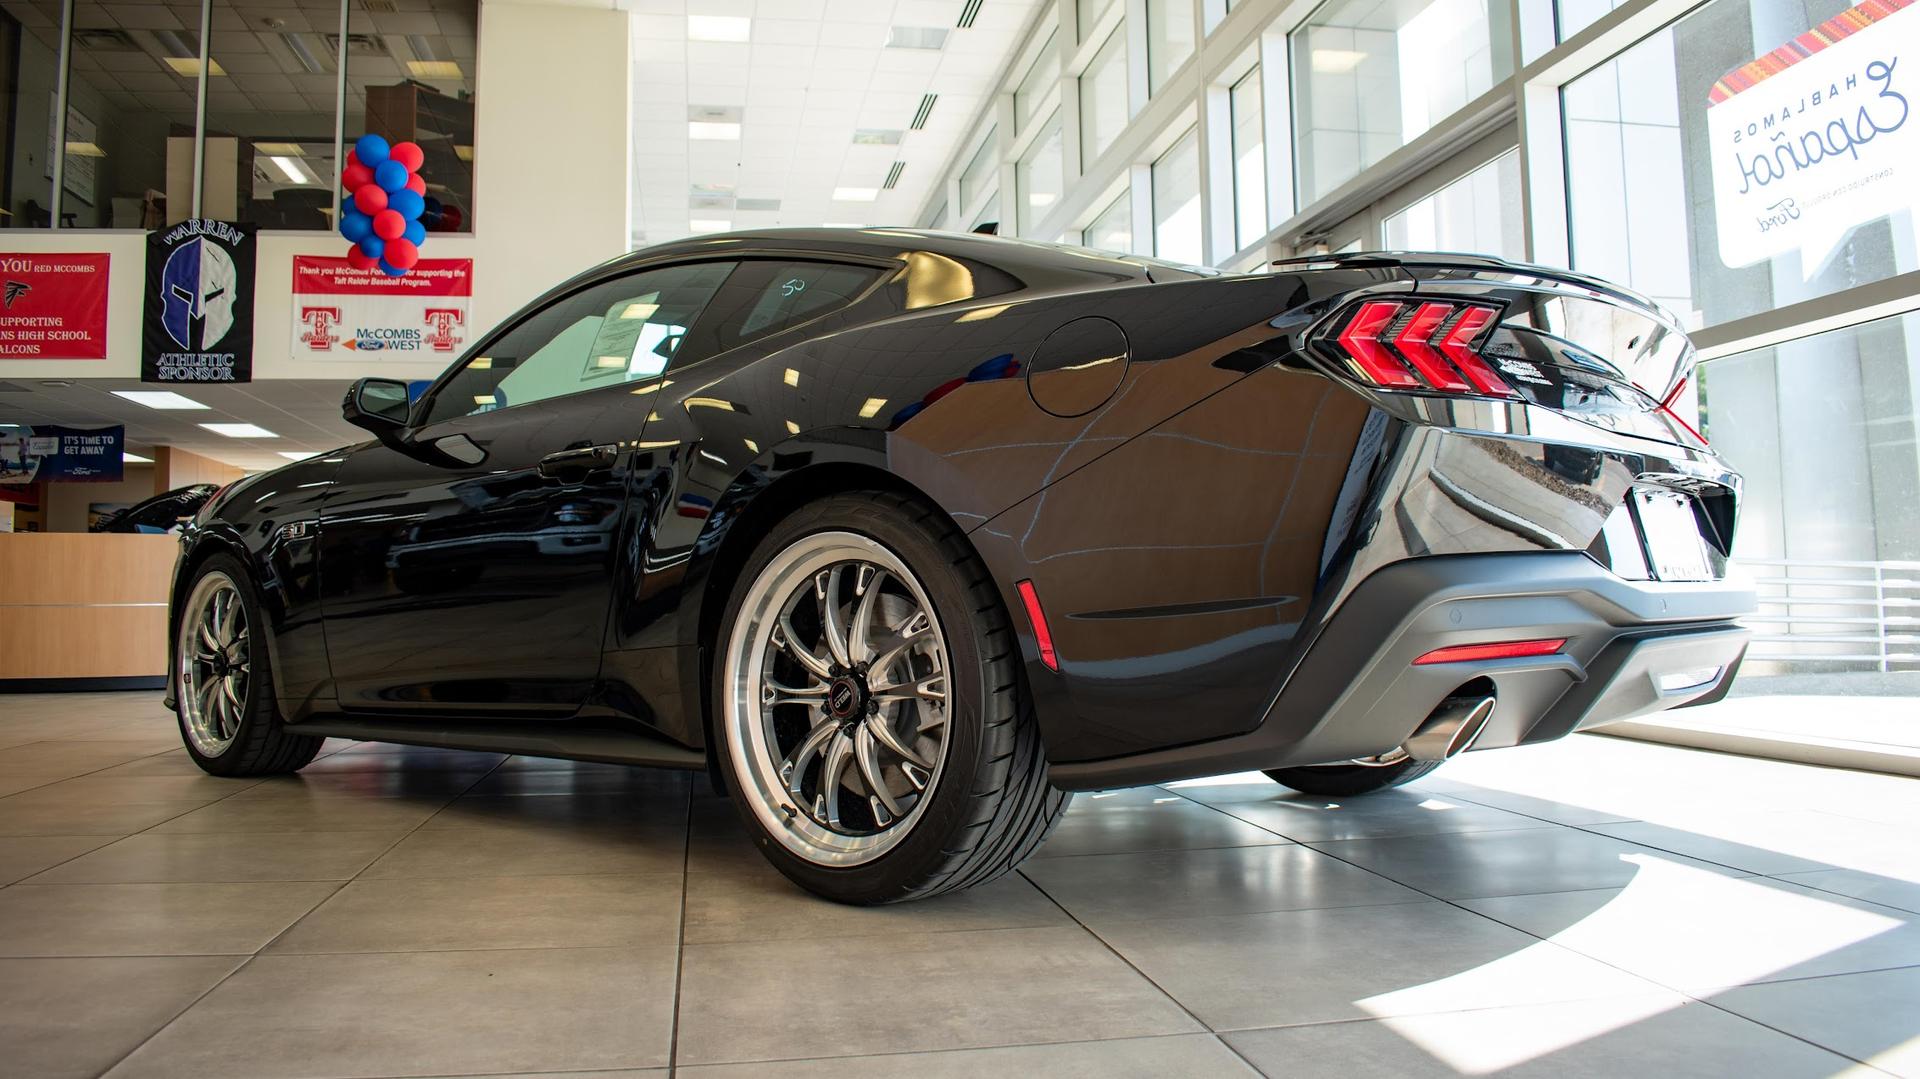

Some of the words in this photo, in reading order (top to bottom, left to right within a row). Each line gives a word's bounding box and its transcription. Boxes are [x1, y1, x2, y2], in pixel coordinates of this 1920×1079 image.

[163, 217, 245, 247] WARREN
[0, 258, 32, 273] YOU
[34, 265, 52, 273] RED
[53, 265, 96, 273] MCCOMBS
[299, 265, 320, 275] Thank
[320, 267, 334, 277] you
[416, 269, 453, 279] supporting
[454, 270, 466, 278] the
[334, 276, 346, 285] Taft
[347, 276, 370, 285] Raider
[370, 277, 400, 286] Baseball
[400, 277, 432, 288] Program.
[18, 331, 45, 341] HIGH
[47, 331, 91, 341] SCHOOL
[356, 328, 421, 339] McCOMBS
[388, 340, 421, 350] WEST
[156, 353, 235, 367] ATHLETIC
[158, 366, 235, 380] SPONSOR
[64, 436, 79, 445] IT'S
[80, 436, 101, 445] TIME
[103, 435, 115, 445] TO
[64, 446, 79, 455] GET
[80, 446, 105, 455] AWAY
[72, 467, 92, 476] Ford
